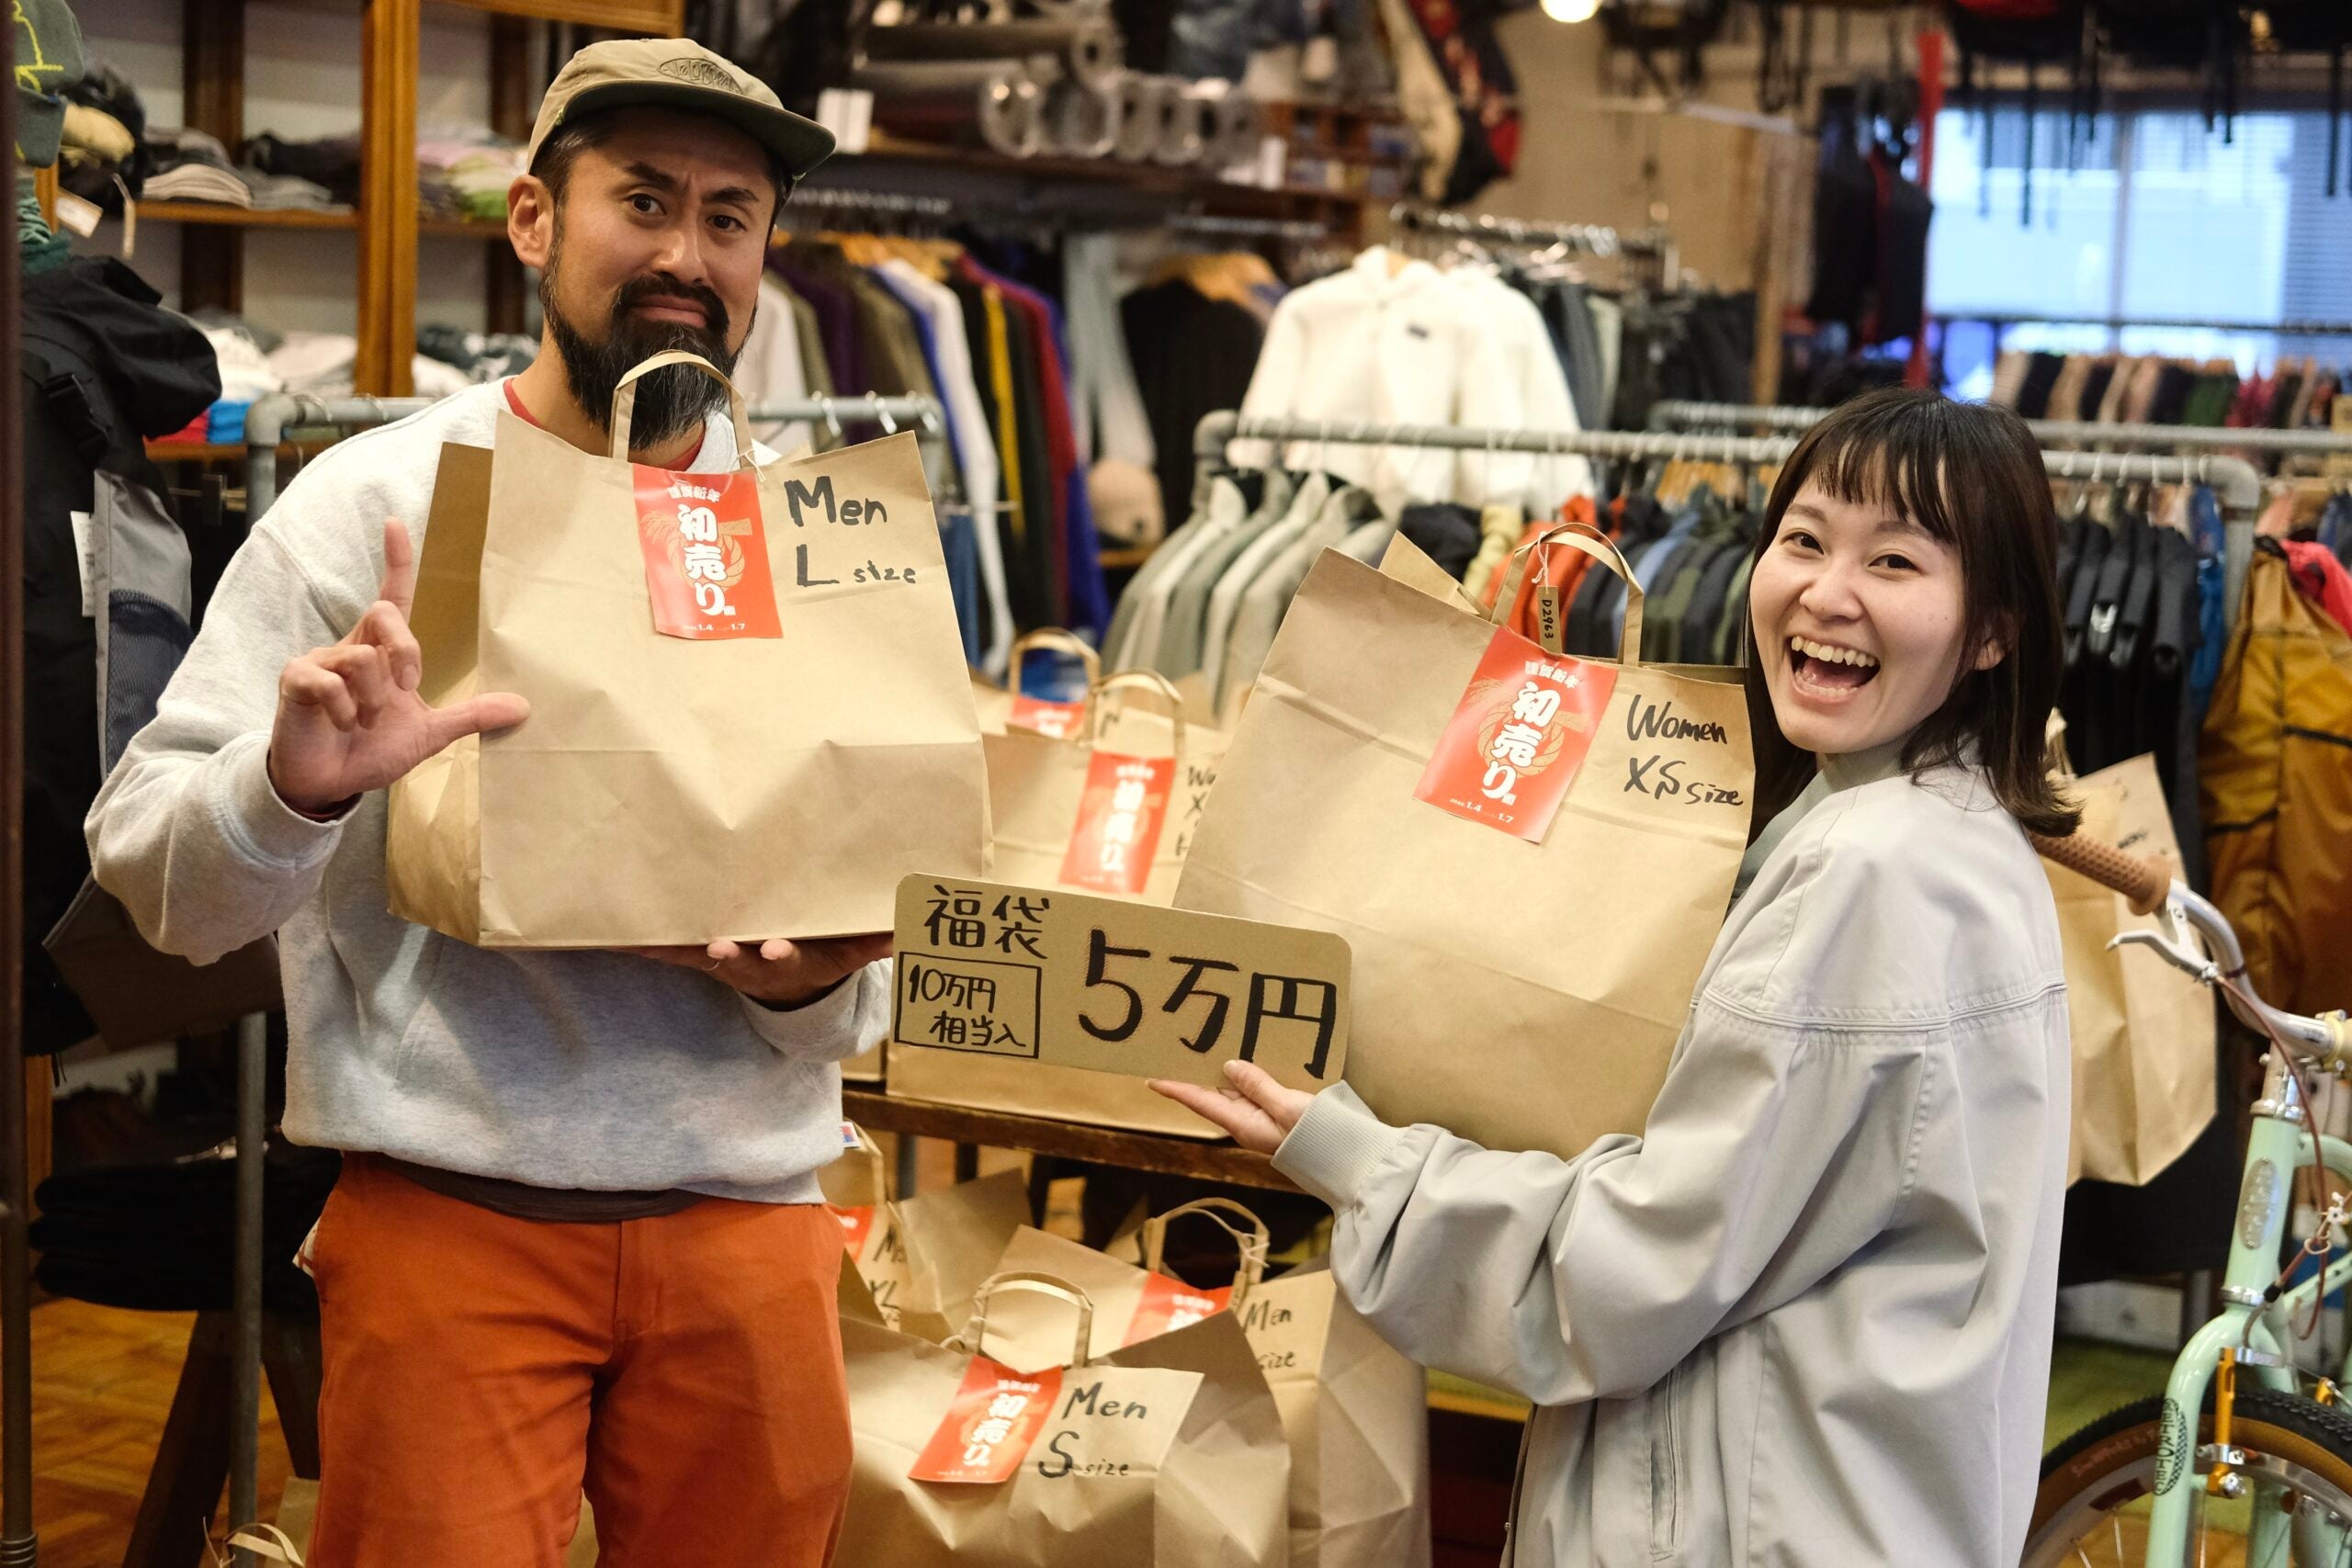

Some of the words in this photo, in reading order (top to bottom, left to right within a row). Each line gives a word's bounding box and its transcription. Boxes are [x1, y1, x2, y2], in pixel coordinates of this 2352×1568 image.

[784, 476, 887, 527] Men
[677, 503, 728, 616] 初売り
[796, 544, 840, 587] L
[853, 559, 916, 584] size
[1542, 599, 1555, 639] D2963
[1481, 681, 1561, 799] 初売り
[1626, 694, 1727, 745] Women
[1624, 755, 1685, 800] XS
[1684, 784, 1744, 806] size
[923, 885, 1051, 959] 福袋
[909, 964, 997, 1013] 10万円
[1078, 928, 1338, 1080] 5万円
[930, 1010, 1027, 1048] 相当入
[1244, 1300, 1292, 1333] Men
[1061, 1382, 1148, 1420] Men
[1038, 1430, 1080, 1479] S
[1085, 1461, 1130, 1477] size
